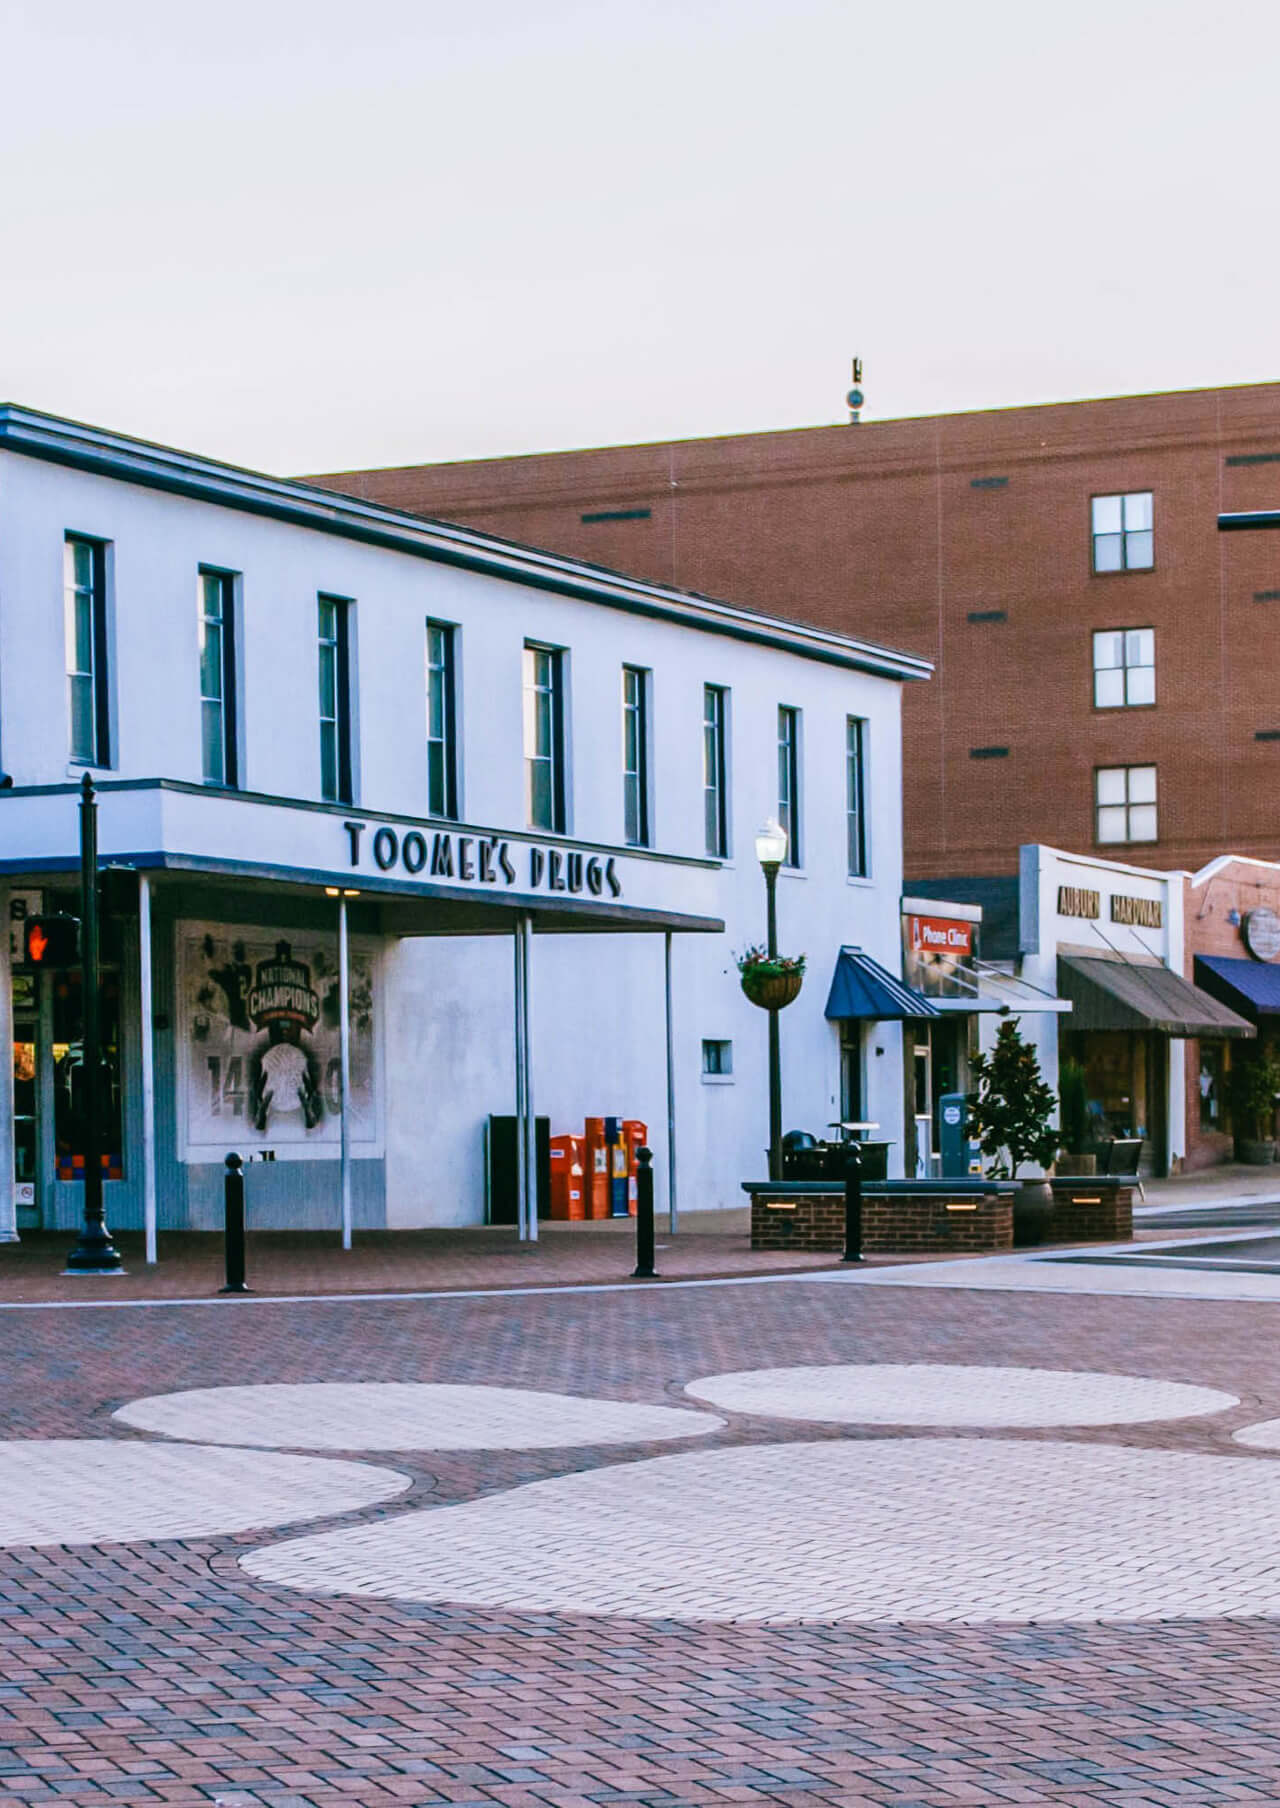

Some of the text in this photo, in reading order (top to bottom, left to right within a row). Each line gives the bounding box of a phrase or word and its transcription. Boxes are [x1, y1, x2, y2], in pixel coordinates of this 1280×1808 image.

[343, 821, 622, 898] TOOMER'S DRUGS
[1056, 886, 1100, 919] AUBURN
[923, 925, 969, 947] Phone Clinic
[261, 967, 306, 986] NATIONAL
[250, 986, 319, 1017] CHAMPIONS
